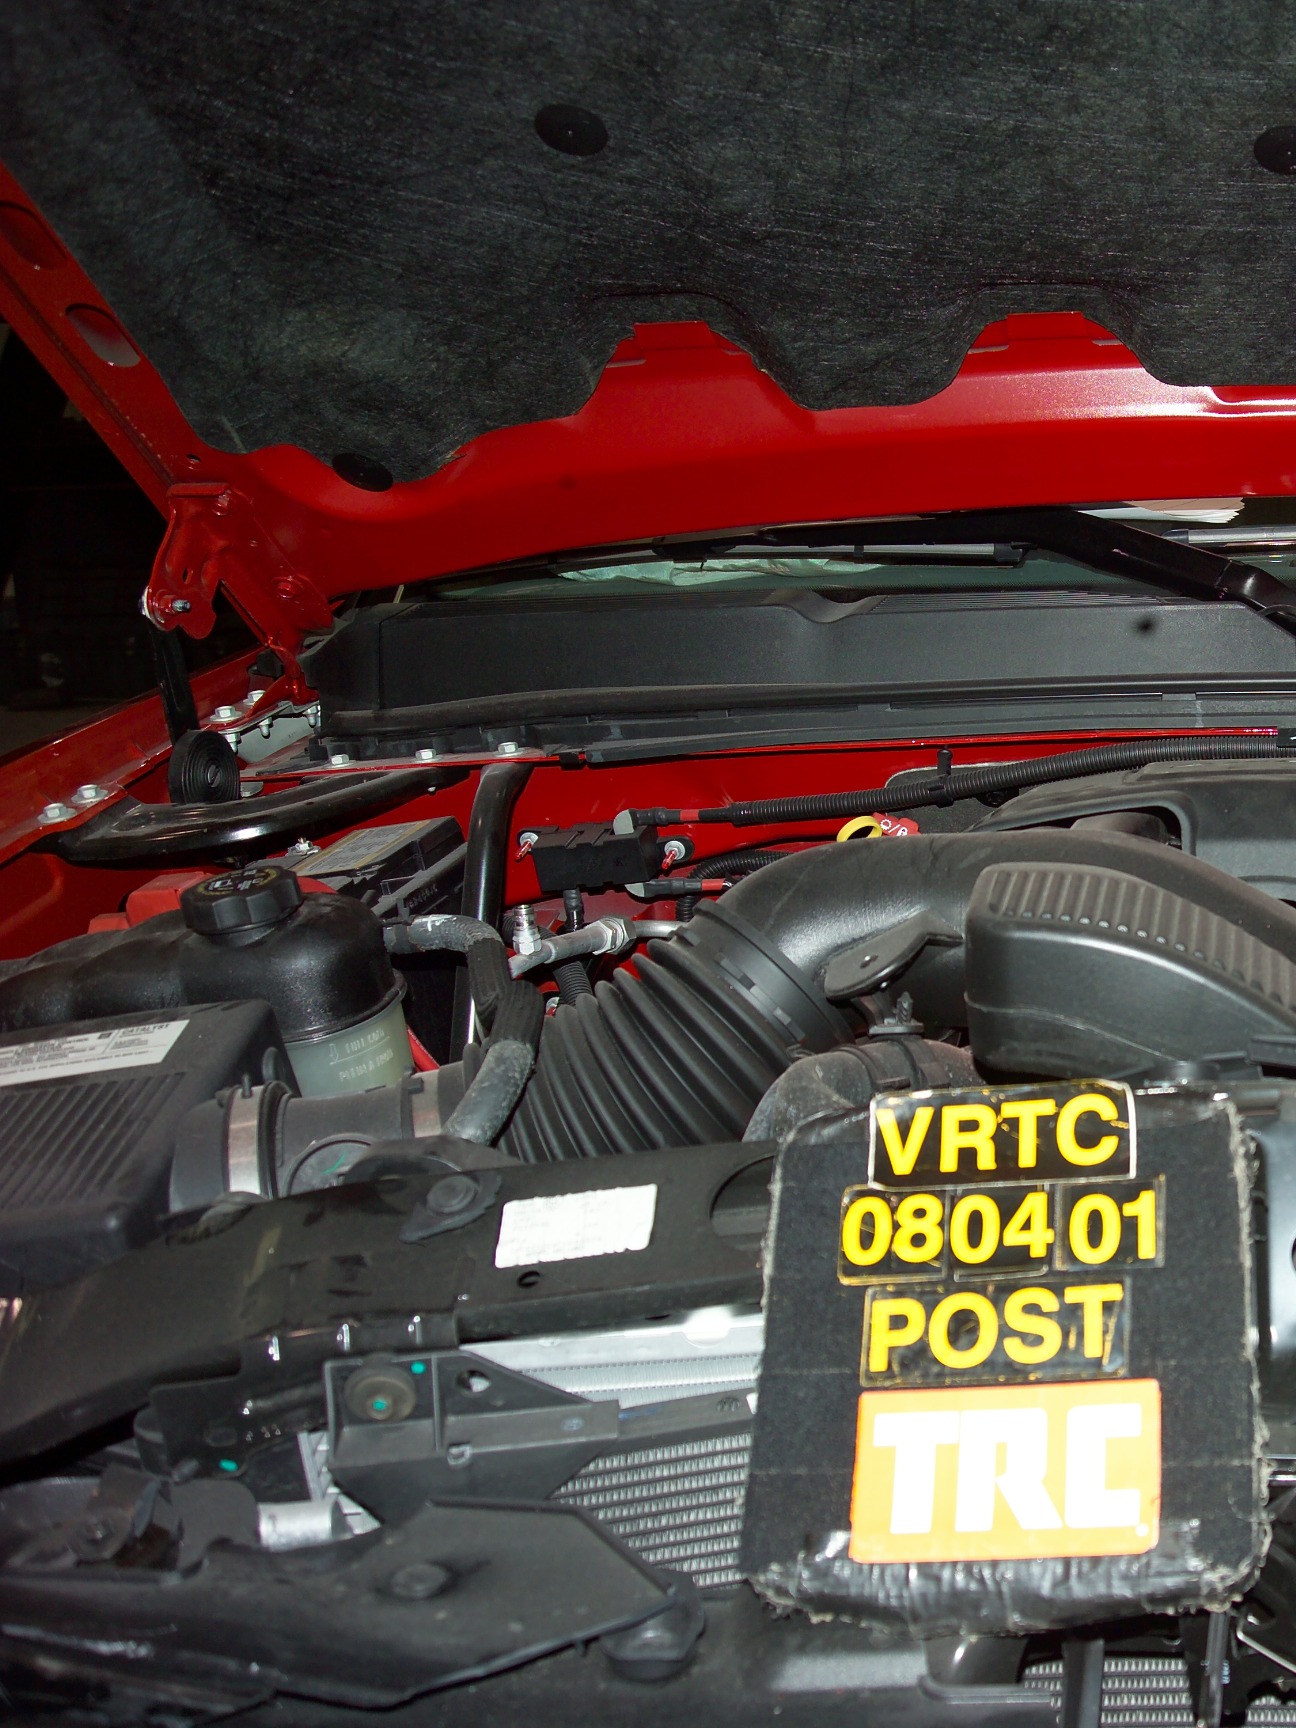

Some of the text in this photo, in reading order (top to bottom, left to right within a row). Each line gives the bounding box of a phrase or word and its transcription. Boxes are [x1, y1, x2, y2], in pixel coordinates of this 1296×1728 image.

[875, 1093, 1119, 1176] VRTC
[868, 1283, 1125, 1373] POST
[872, 1402, 1144, 1535] TRC
